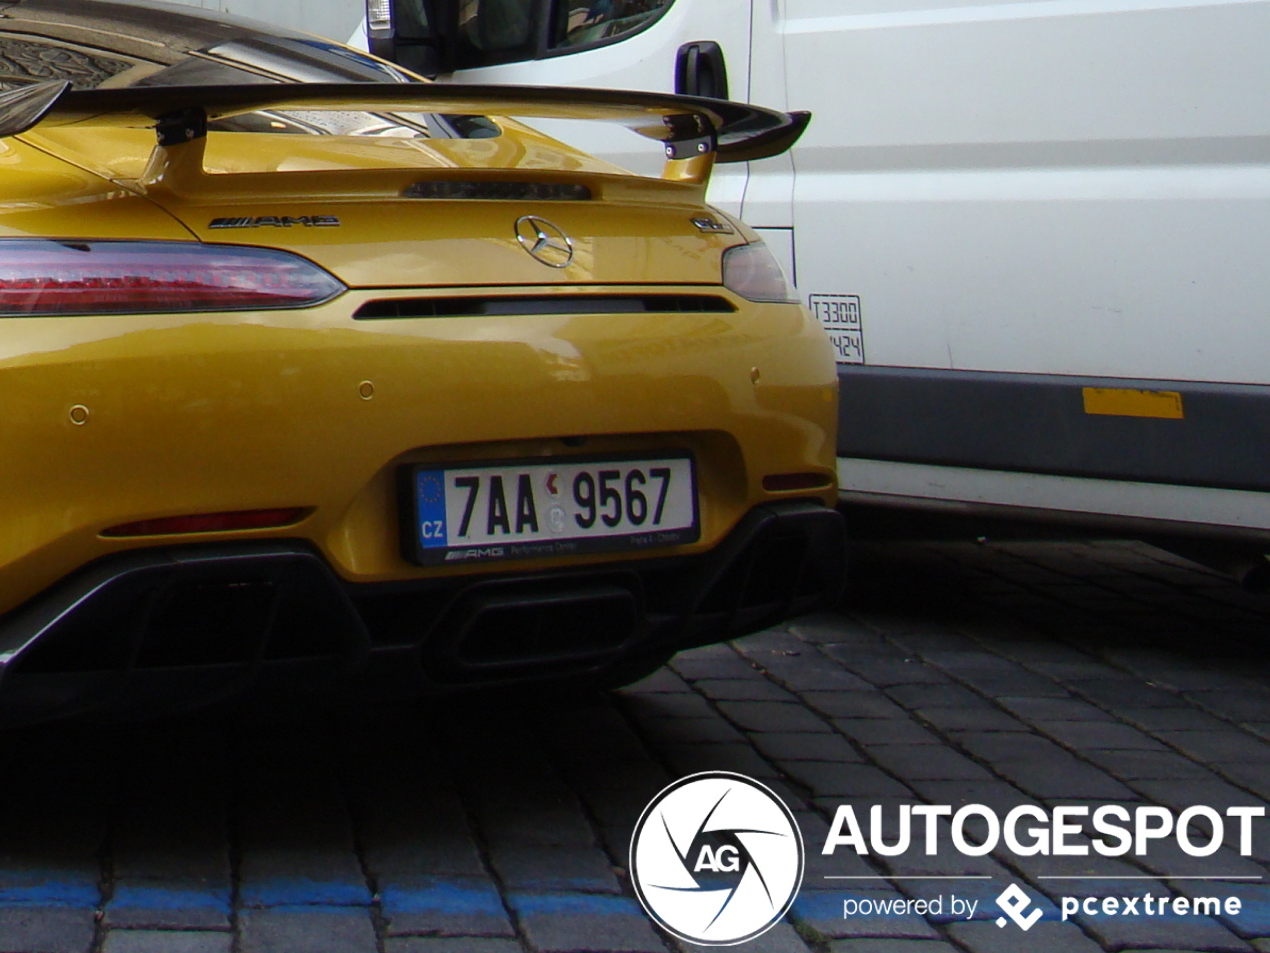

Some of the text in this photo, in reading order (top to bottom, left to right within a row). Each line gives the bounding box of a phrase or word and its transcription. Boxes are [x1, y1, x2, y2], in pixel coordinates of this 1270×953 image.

[812, 301, 858, 324] T3300
[830, 335, 861, 357] 424
[453, 467, 672, 538] 7AA 9567
[421, 520, 444, 539] CZ
[463, 547, 505, 559] AMG
